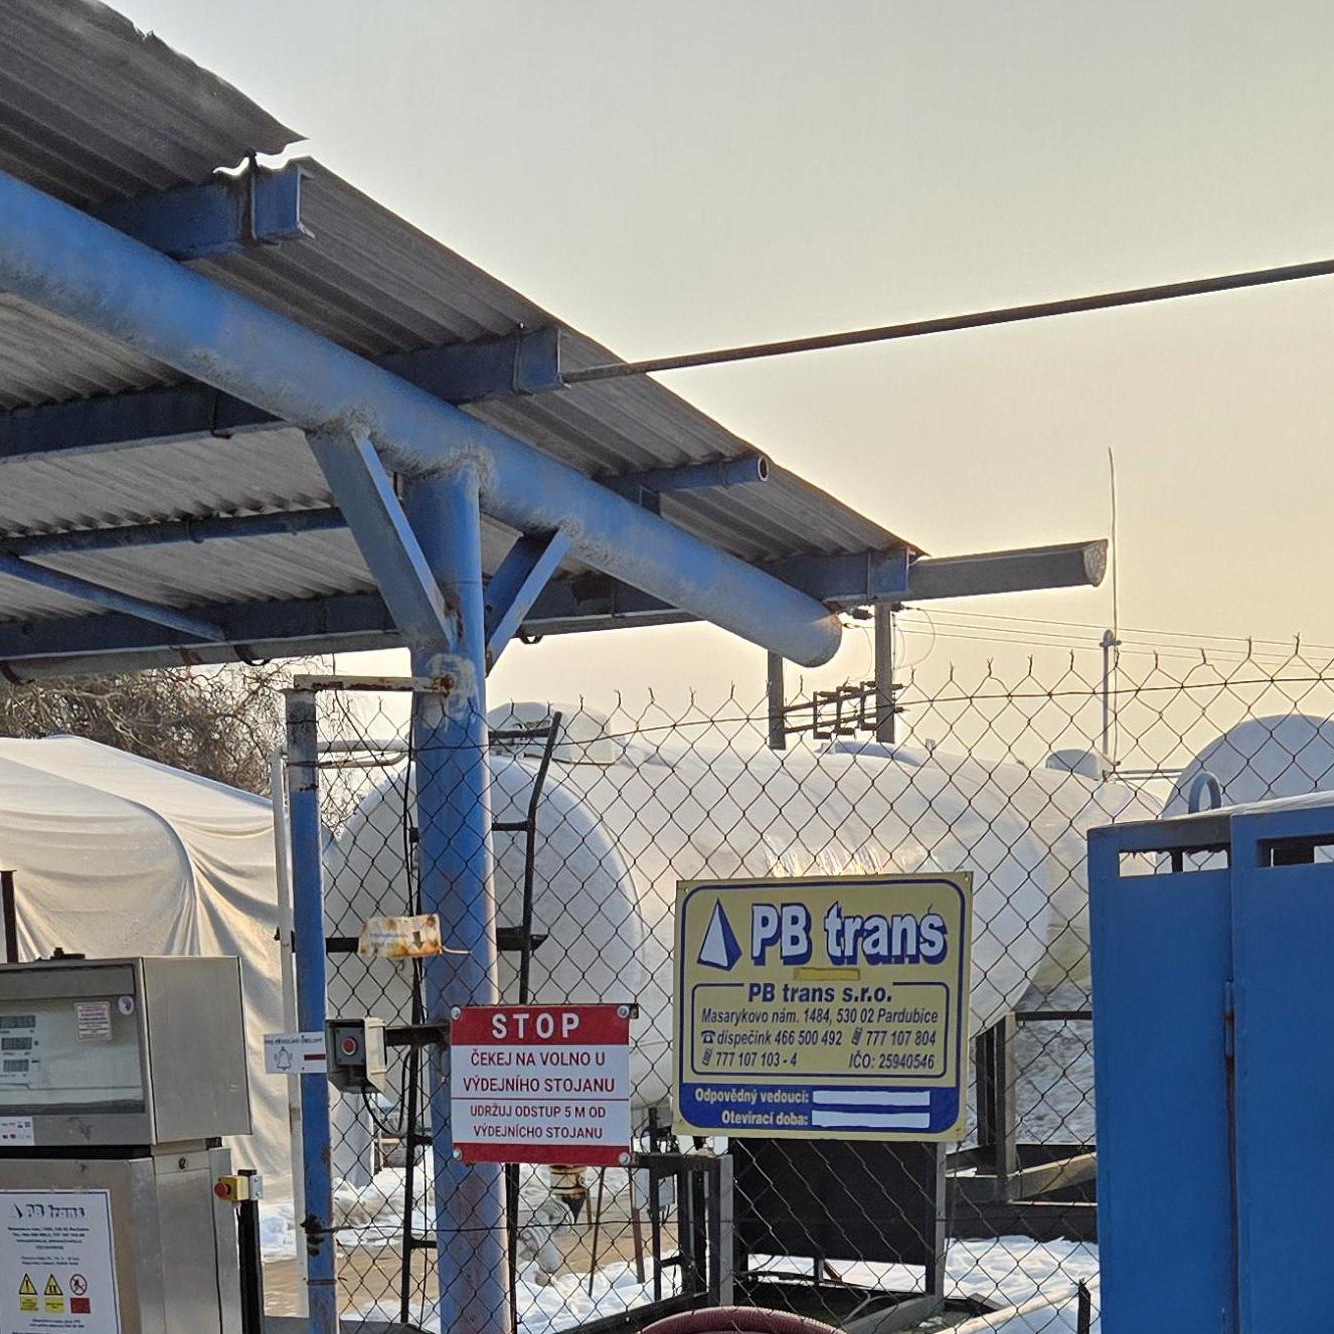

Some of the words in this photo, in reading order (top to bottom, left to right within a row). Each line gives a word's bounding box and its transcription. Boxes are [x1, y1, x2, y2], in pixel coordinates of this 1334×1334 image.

[751, 902, 813, 966] PB
[824, 901, 948, 966] trans
[748, 983, 775, 1002] PB
[782, 984, 835, 1002] trans
[842, 986, 892, 1002] s.r.o.
[491, 1013, 580, 1039] STOP
[701, 1008, 769, 1026] Masarykovo
[771, 1008, 799, 1023] nám.
[803, 1008, 832, 1025] 1484,
[836, 1008, 857, 1023] 530
[860, 1008, 874, 1023] 02
[876, 1008, 939, 1023] Pardubice
[717, 1029, 772, 1048] dispečink
[774, 1030, 795, 1045] 466
[797, 1030, 819, 1045] 500
[821, 1030, 842, 1046] 492
[866, 1030, 887, 1046] 777
[890, 1030, 912, 1046] 107
[914, 1030, 937, 1046] 804
[470, 1048, 512, 1066] ČEKEJ
[515, 1052, 536, 1066] NA
[540, 1052, 591, 1066] VOLNO
[595, 1052, 605, 1066] U
[716, 1051, 736, 1067] 777
[738, 1051, 758, 1067] 107
[761, 1051, 781, 1067] 103
[790, 1051, 798, 1067] 4
[849, 1050, 875, 1068] IČO:
[878, 1054, 935, 1069] 25940546
[463, 1074, 540, 1092] VÝDEJNÍHO
[544, 1078, 615, 1093] STOJANU
[695, 1087, 758, 1105] Odpovědný
[760, 1089, 810, 1103] vedoucí:
[470, 1102, 512, 1117] UDRŽUJ
[515, 1105, 561, 1118] ODSTUP
[564, 1106, 572, 1118] 5
[574, 1107, 585, 1118] M
[589, 1107, 606, 1118] OD
[776, 1112, 809, 1125] doba:
[473, 1123, 543, 1138] VÝDEJNÍCHO
[545, 1126, 603, 1139] STOJANU
